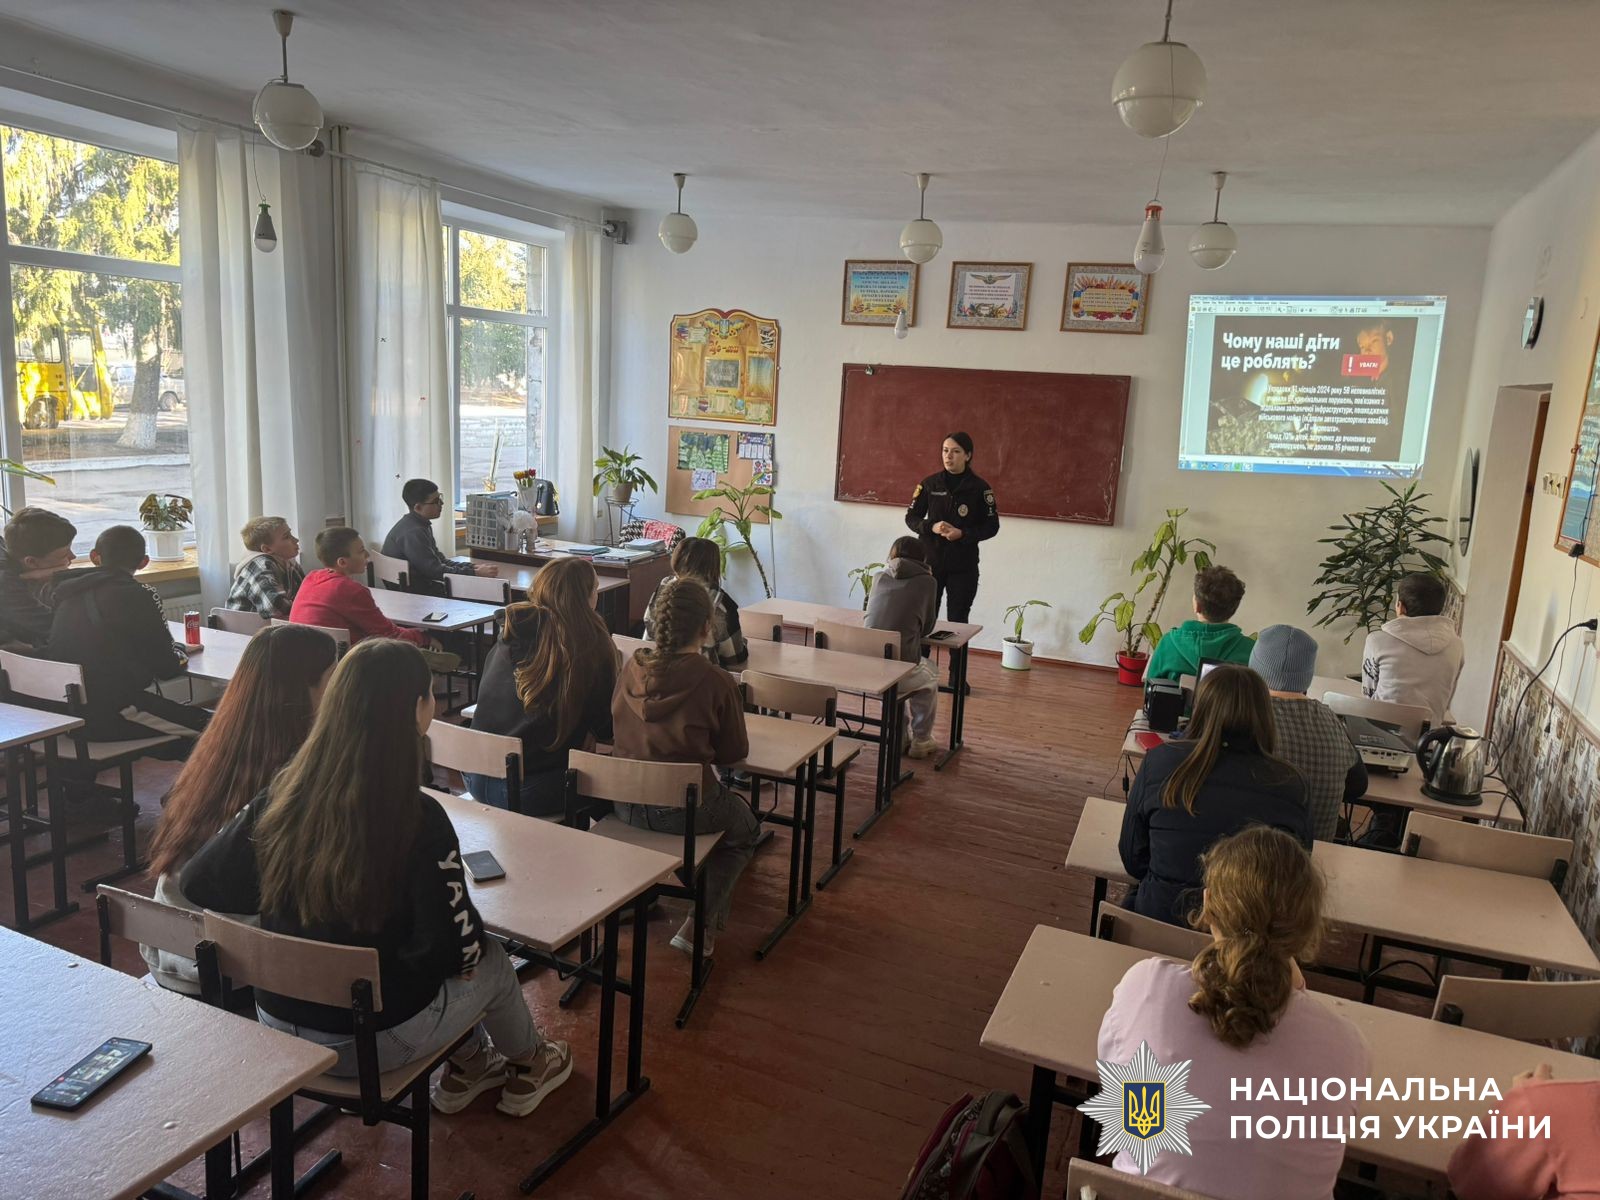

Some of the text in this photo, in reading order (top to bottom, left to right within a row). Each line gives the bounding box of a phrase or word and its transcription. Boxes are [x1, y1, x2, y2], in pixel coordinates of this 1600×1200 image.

[1223, 332, 1341, 353] Чому наші діти
[1221, 353, 1316, 372] це роблять?
[1317, 385, 1330, 394] 2024
